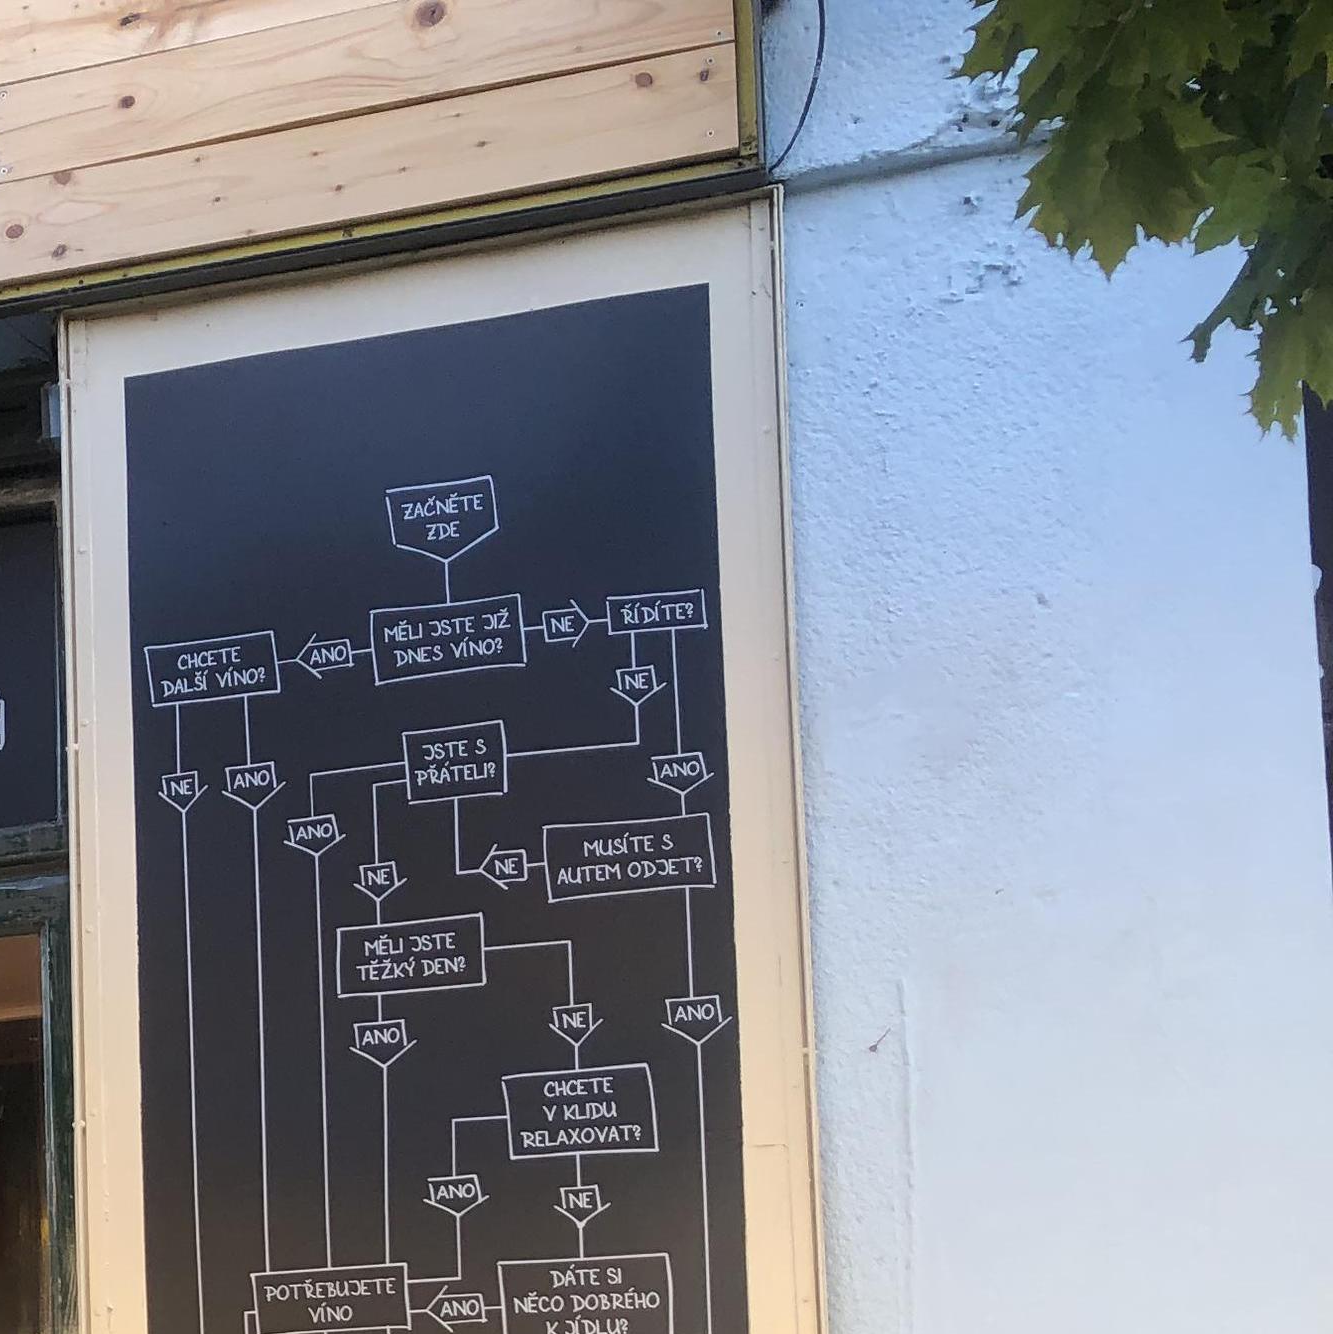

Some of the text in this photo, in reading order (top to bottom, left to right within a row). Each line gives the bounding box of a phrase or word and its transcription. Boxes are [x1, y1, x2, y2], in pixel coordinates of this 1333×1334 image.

[401, 492, 483, 520] ZAČNĚTE
[425, 520, 460, 541] ZDE
[620, 599, 694, 625] ŘÍDÍTE?
[384, 607, 511, 643] MĚLI JSTE JIŽ
[550, 615, 575, 633] NE
[177, 646, 241, 672] CHCETE
[309, 645, 347, 666] ANO
[393, 636, 504, 668] DNES VÍNO?
[160, 666, 266, 698] DALŠÍ VÍNO?
[624, 672, 649, 690] NE
[422, 738, 487, 761] JSTE S
[233, 769, 270, 790] ANO
[414, 760, 496, 786] PŘÁTELI?
[660, 760, 700, 779] ANO
[170, 778, 193, 797] NE
[295, 823, 333, 841] ANO
[583, 832, 674, 858] MUSÍTE S
[367, 868, 390, 886] NE
[494, 857, 519, 876] NE
[557, 856, 703, 885] AUTEM ODJET?
[364, 932, 456, 957] MĚLI JSTE
[355, 955, 467, 981] TĚŽKÝ DEN?
[561, 1011, 587, 1029] NE
[674, 1003, 715, 1023] ANO
[361, 1027, 400, 1046] ANO
[543, 1076, 614, 1098] CHCETE
[542, 1101, 618, 1122] V KLIDU
[520, 1124, 642, 1149] RELAXOVAT?
[436, 1183, 476, 1201] ANO
[568, 1191, 593, 1209] NE
[549, 1263, 622, 1289] DÁTE SI
[263, 1277, 396, 1303] POTŘEBUJETE
[513, 1287, 660, 1314] NĚCO DOBRÉHO
[307, 1301, 353, 1324] VÍNO
[440, 1299, 480, 1318] ANO
